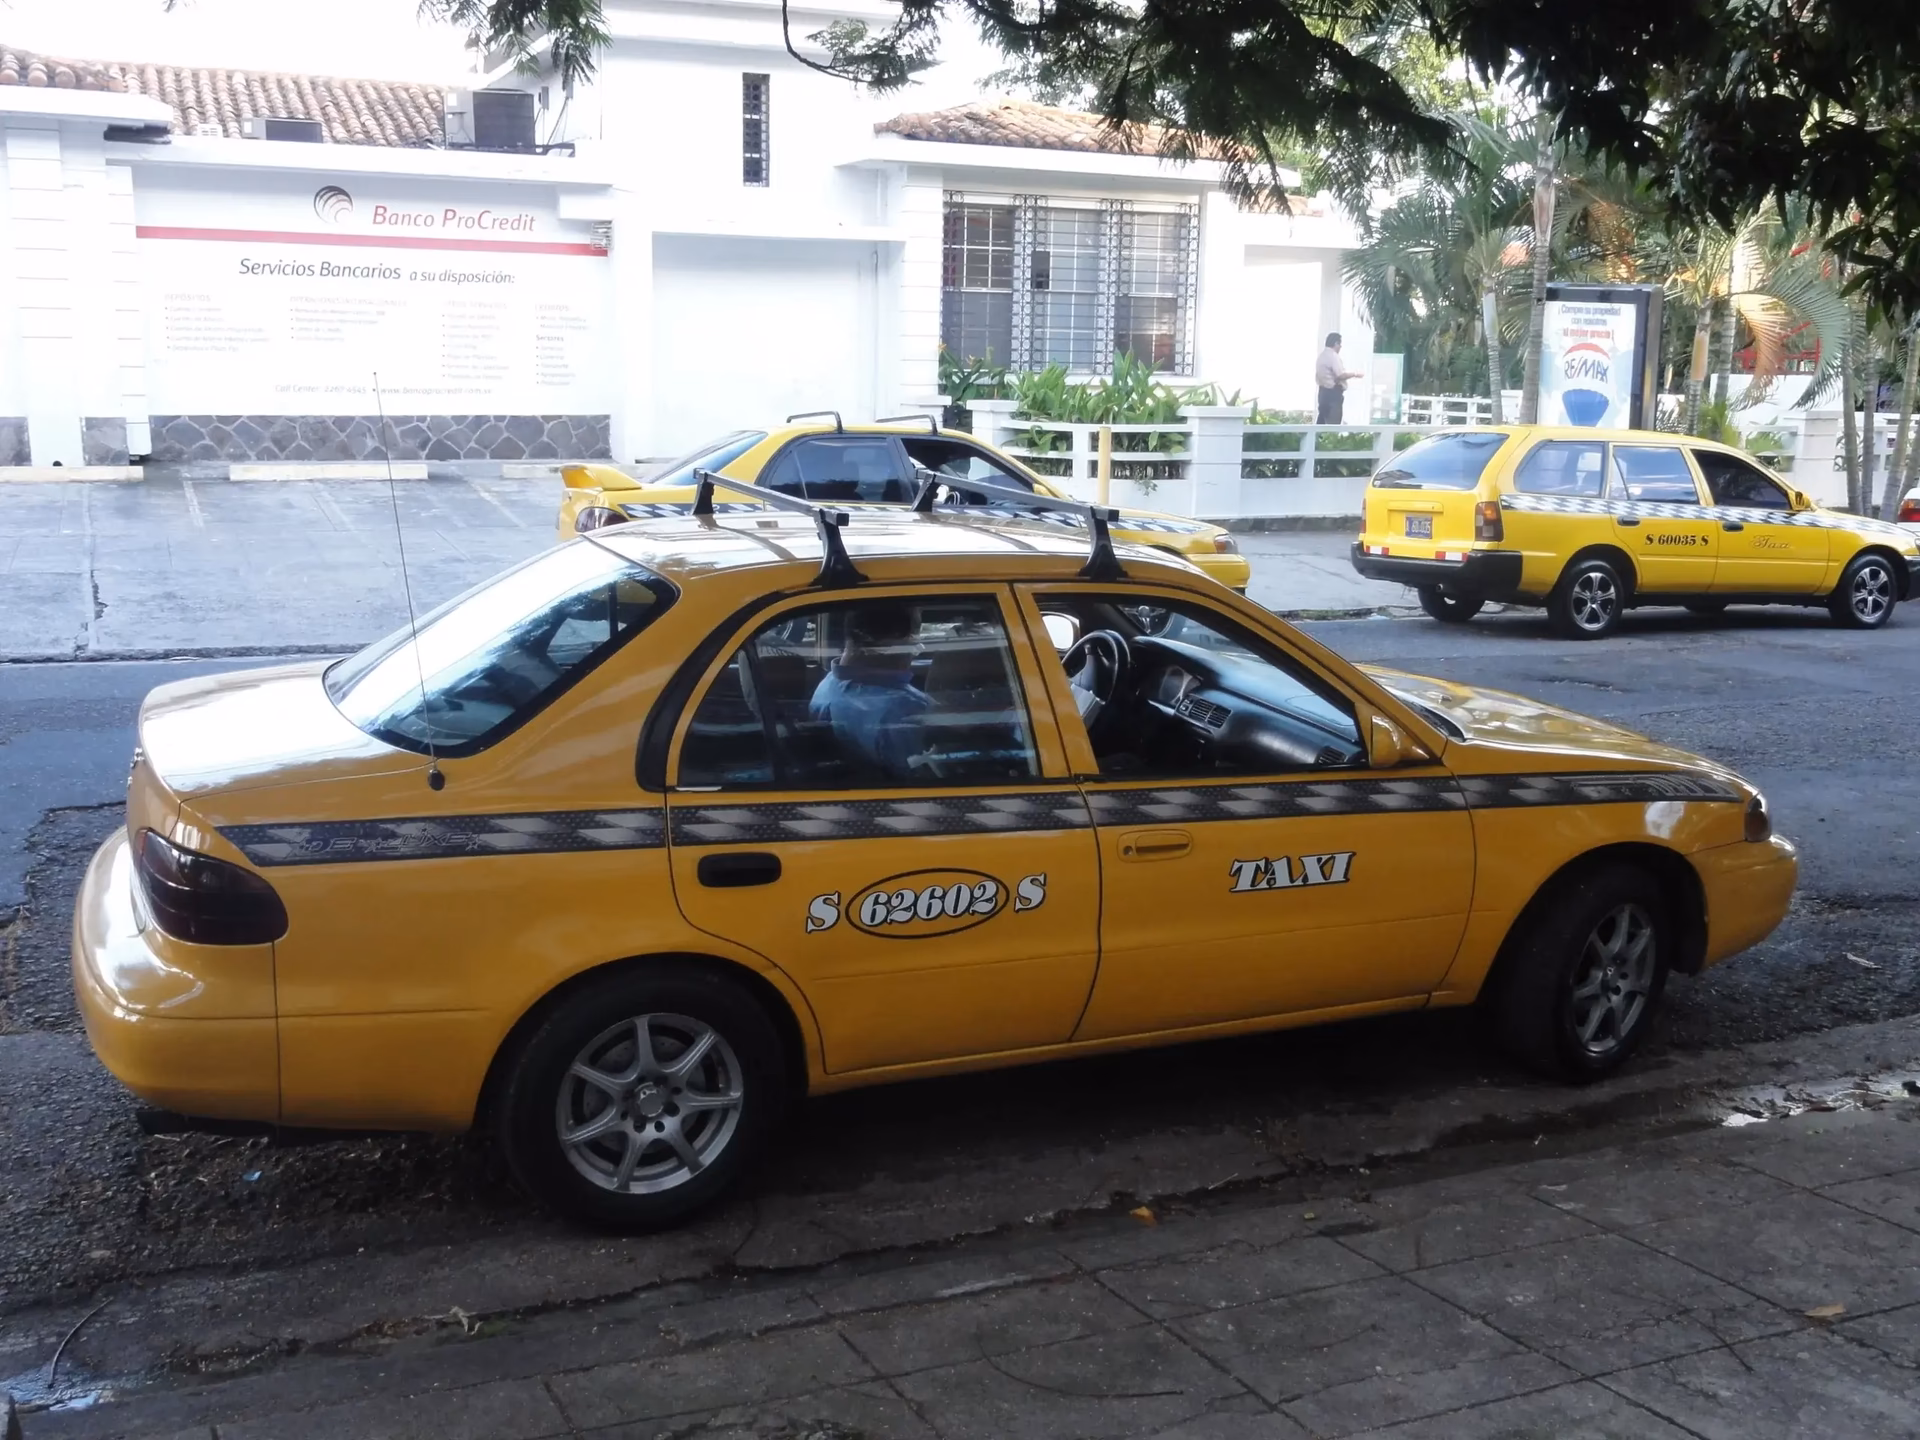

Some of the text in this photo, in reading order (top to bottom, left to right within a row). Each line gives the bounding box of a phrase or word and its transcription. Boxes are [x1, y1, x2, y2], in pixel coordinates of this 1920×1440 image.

[372, 205, 536, 231] Banco ProCredit
[239, 258, 515, 285] Servicios Bancarios a su disposición:
[1564, 356, 1609, 384] RE/MAX
[1644, 533, 1709, 547] S 60035 S
[1228, 851, 1357, 893] TAXI
[805, 873, 1047, 934] S 62602 S
